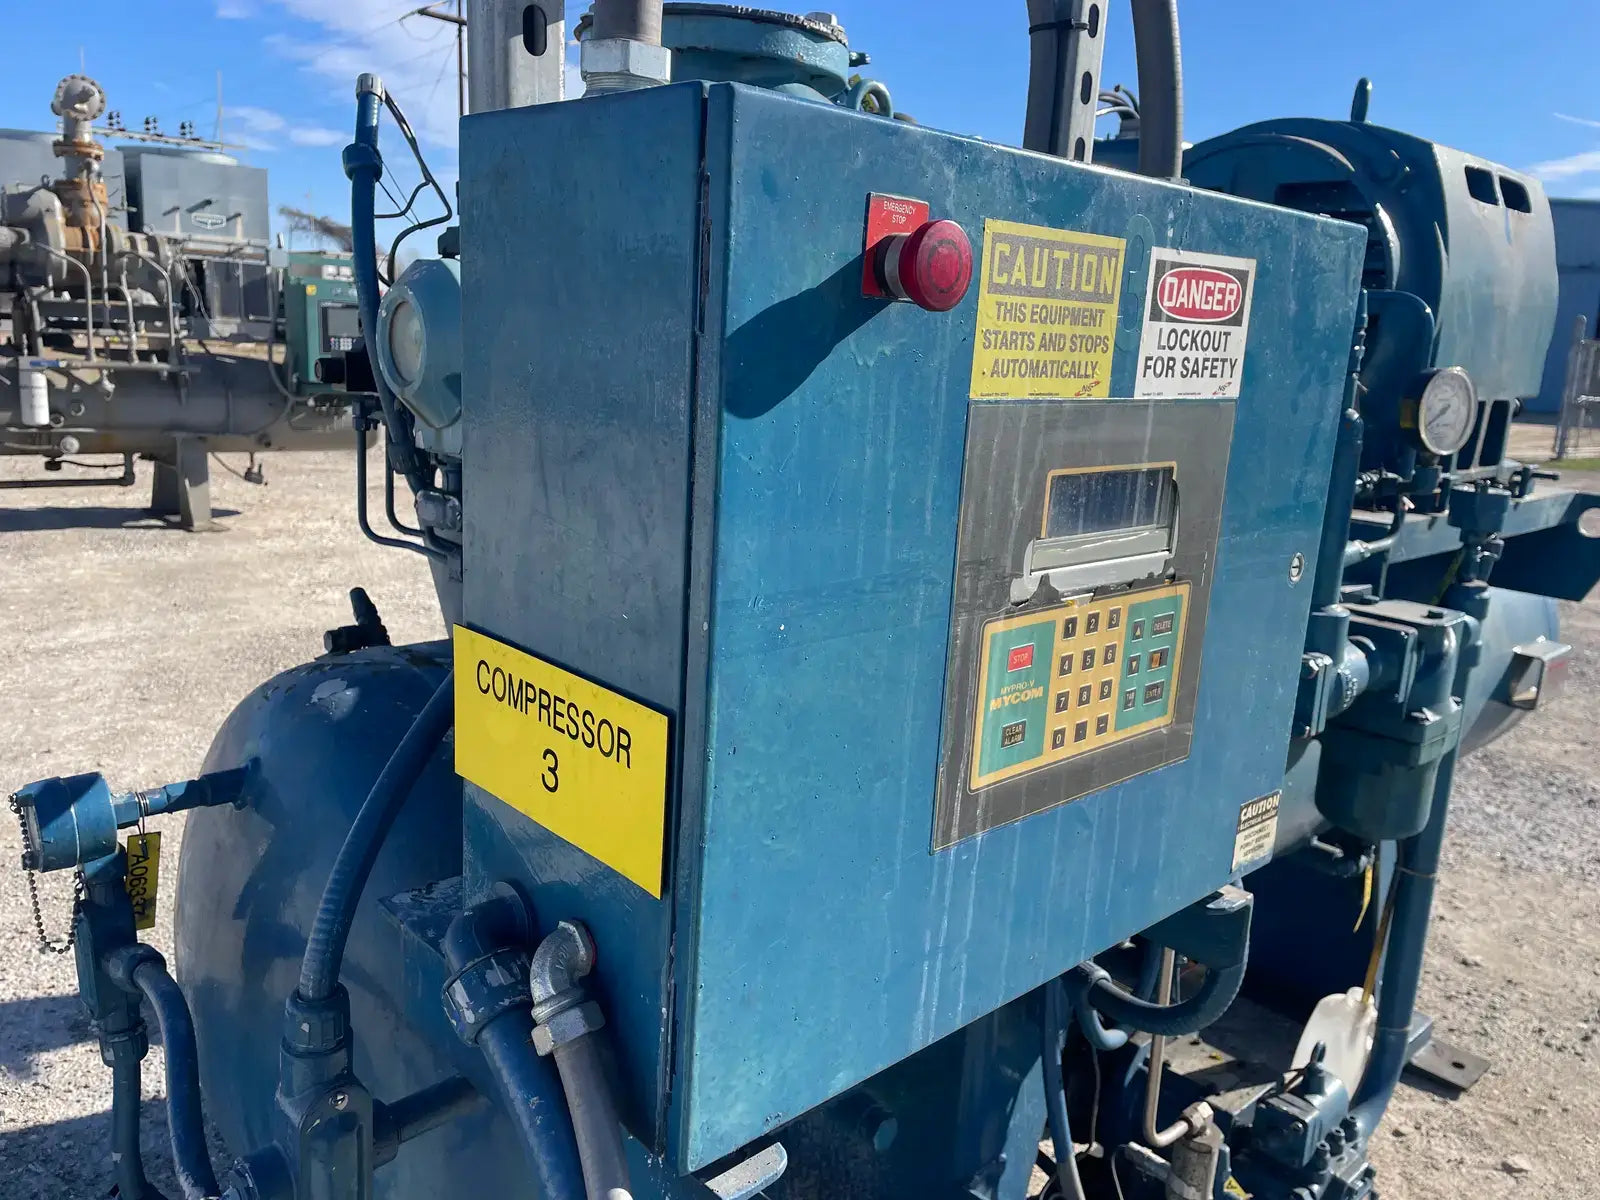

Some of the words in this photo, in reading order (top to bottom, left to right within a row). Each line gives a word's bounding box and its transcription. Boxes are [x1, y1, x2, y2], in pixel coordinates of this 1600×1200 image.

[884, 201, 916, 214] EMERGENCY
[892, 214, 907, 224] STOP
[993, 243, 1116, 294] CAUTION
[1163, 277, 1237, 311] DANGER
[996, 301, 1027, 323] THIS
[1030, 304, 1105, 327] EQUIPMENT
[983, 328, 1035, 351] STARTS
[1039, 333, 1066, 352] AND
[1070, 334, 1109, 353] STOPS
[1157, 328, 1231, 352] LOCKOUT
[990, 358, 1099, 379] AUTOMATICALLY
[1143, 356, 1176, 378] FOR
[1180, 357, 1238, 379] SAFETY
[1068, 623, 1072, 633] 1
[1090, 618, 1095, 629] 2
[1111, 614, 1117, 624] 3
[1153, 620, 1171, 632] DELETE
[1013, 653, 1028, 664] STOP
[1063, 660, 1069, 671] 4
[1086, 655, 1091, 665] 5
[1107, 650, 1112, 660] 6
[990, 686, 1044, 712] MYCOM
[1060, 697, 1065, 708] 7
[1082, 691, 1087, 702] 8
[1103, 685, 1109, 696] 9
[1146, 688, 1161, 699] ENTER
[476, 660, 632, 769] COMPRESSOR
[1004, 734, 1022, 746] ALARM
[1005, 725, 1022, 736] CLEAR
[1056, 734, 1061, 744] 0
[541, 748, 559, 793] 3
[1240, 794, 1280, 821] CAUTION
